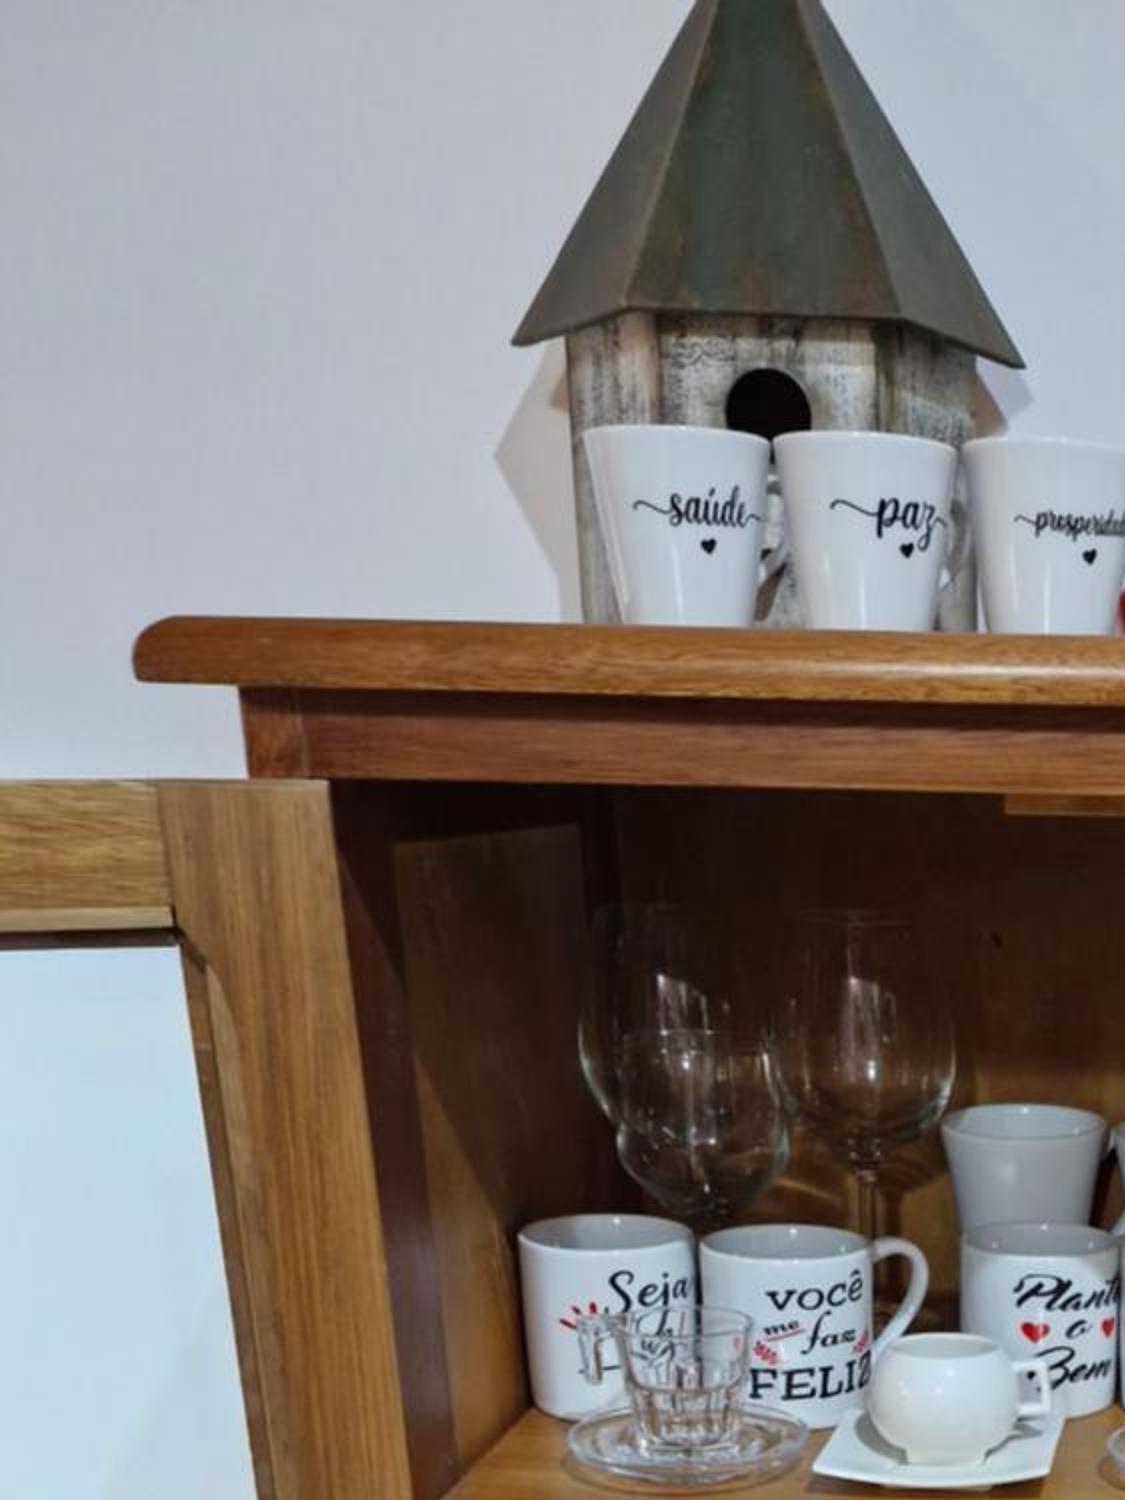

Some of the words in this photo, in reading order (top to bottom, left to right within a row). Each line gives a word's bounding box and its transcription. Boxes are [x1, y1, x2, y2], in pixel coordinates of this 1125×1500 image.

[631, 485, 766, 528] saúde
[829, 496, 948, 552] paz
[608, 1269, 689, 1337] Seja
[764, 1268, 864, 1311] você
[763, 1320, 800, 1336] me
[800, 1309, 857, 1356] faz
[748, 1349, 873, 1402] FELIZ
[1027, 1345, 1112, 1391] Bem
